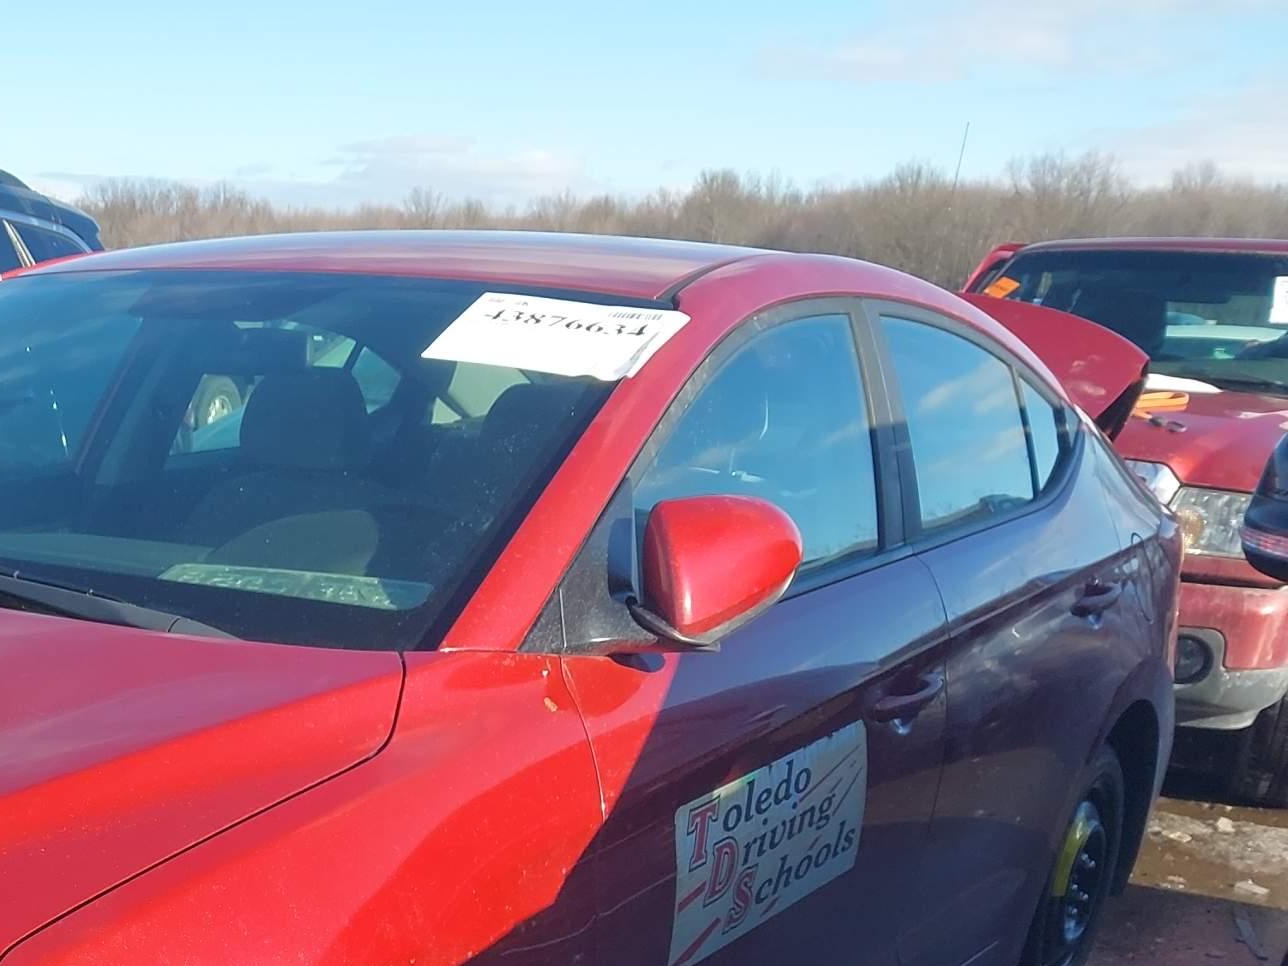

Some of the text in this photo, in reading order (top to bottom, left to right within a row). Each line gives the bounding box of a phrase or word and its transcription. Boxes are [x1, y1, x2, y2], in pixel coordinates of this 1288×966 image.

[484, 308, 649, 337] 43876634
[687, 760, 811, 872] Toledo
[703, 790, 835, 907] Driving
[722, 821, 855, 935] Schools
